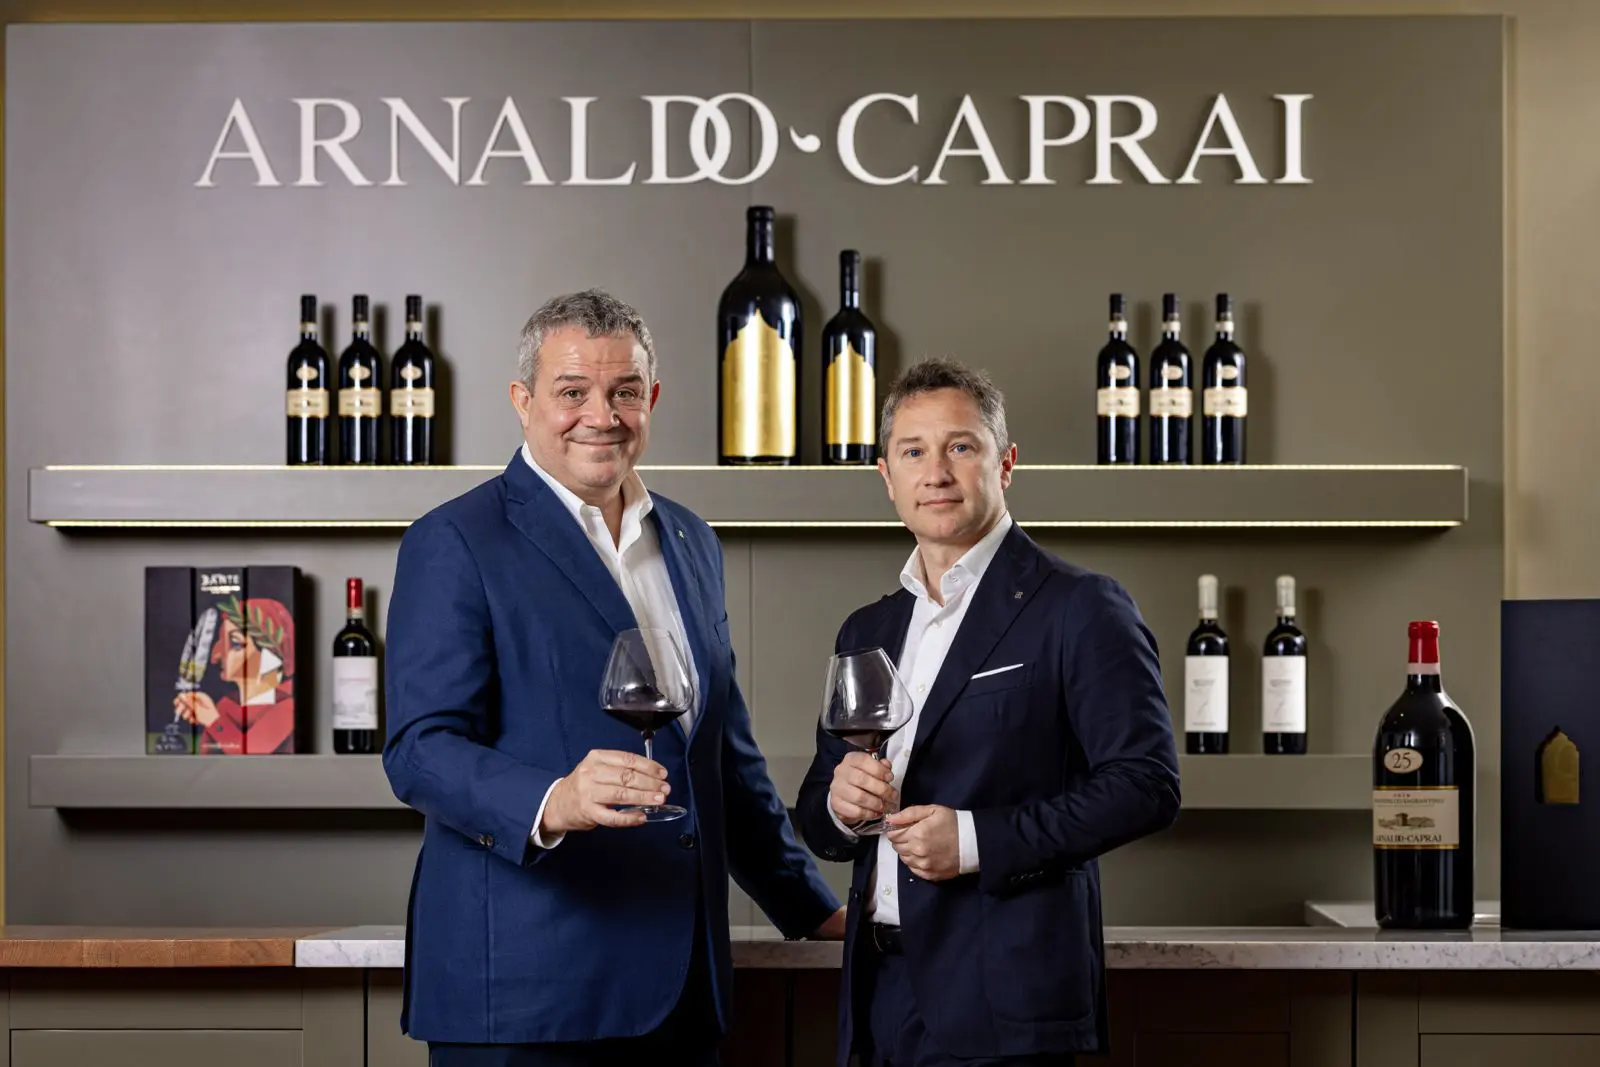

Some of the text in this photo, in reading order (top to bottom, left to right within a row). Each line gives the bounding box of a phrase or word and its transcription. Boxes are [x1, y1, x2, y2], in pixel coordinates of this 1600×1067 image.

[194, 92, 1314, 187] ARNALDO CAPRAI
[1392, 751, 1412, 770] 25
